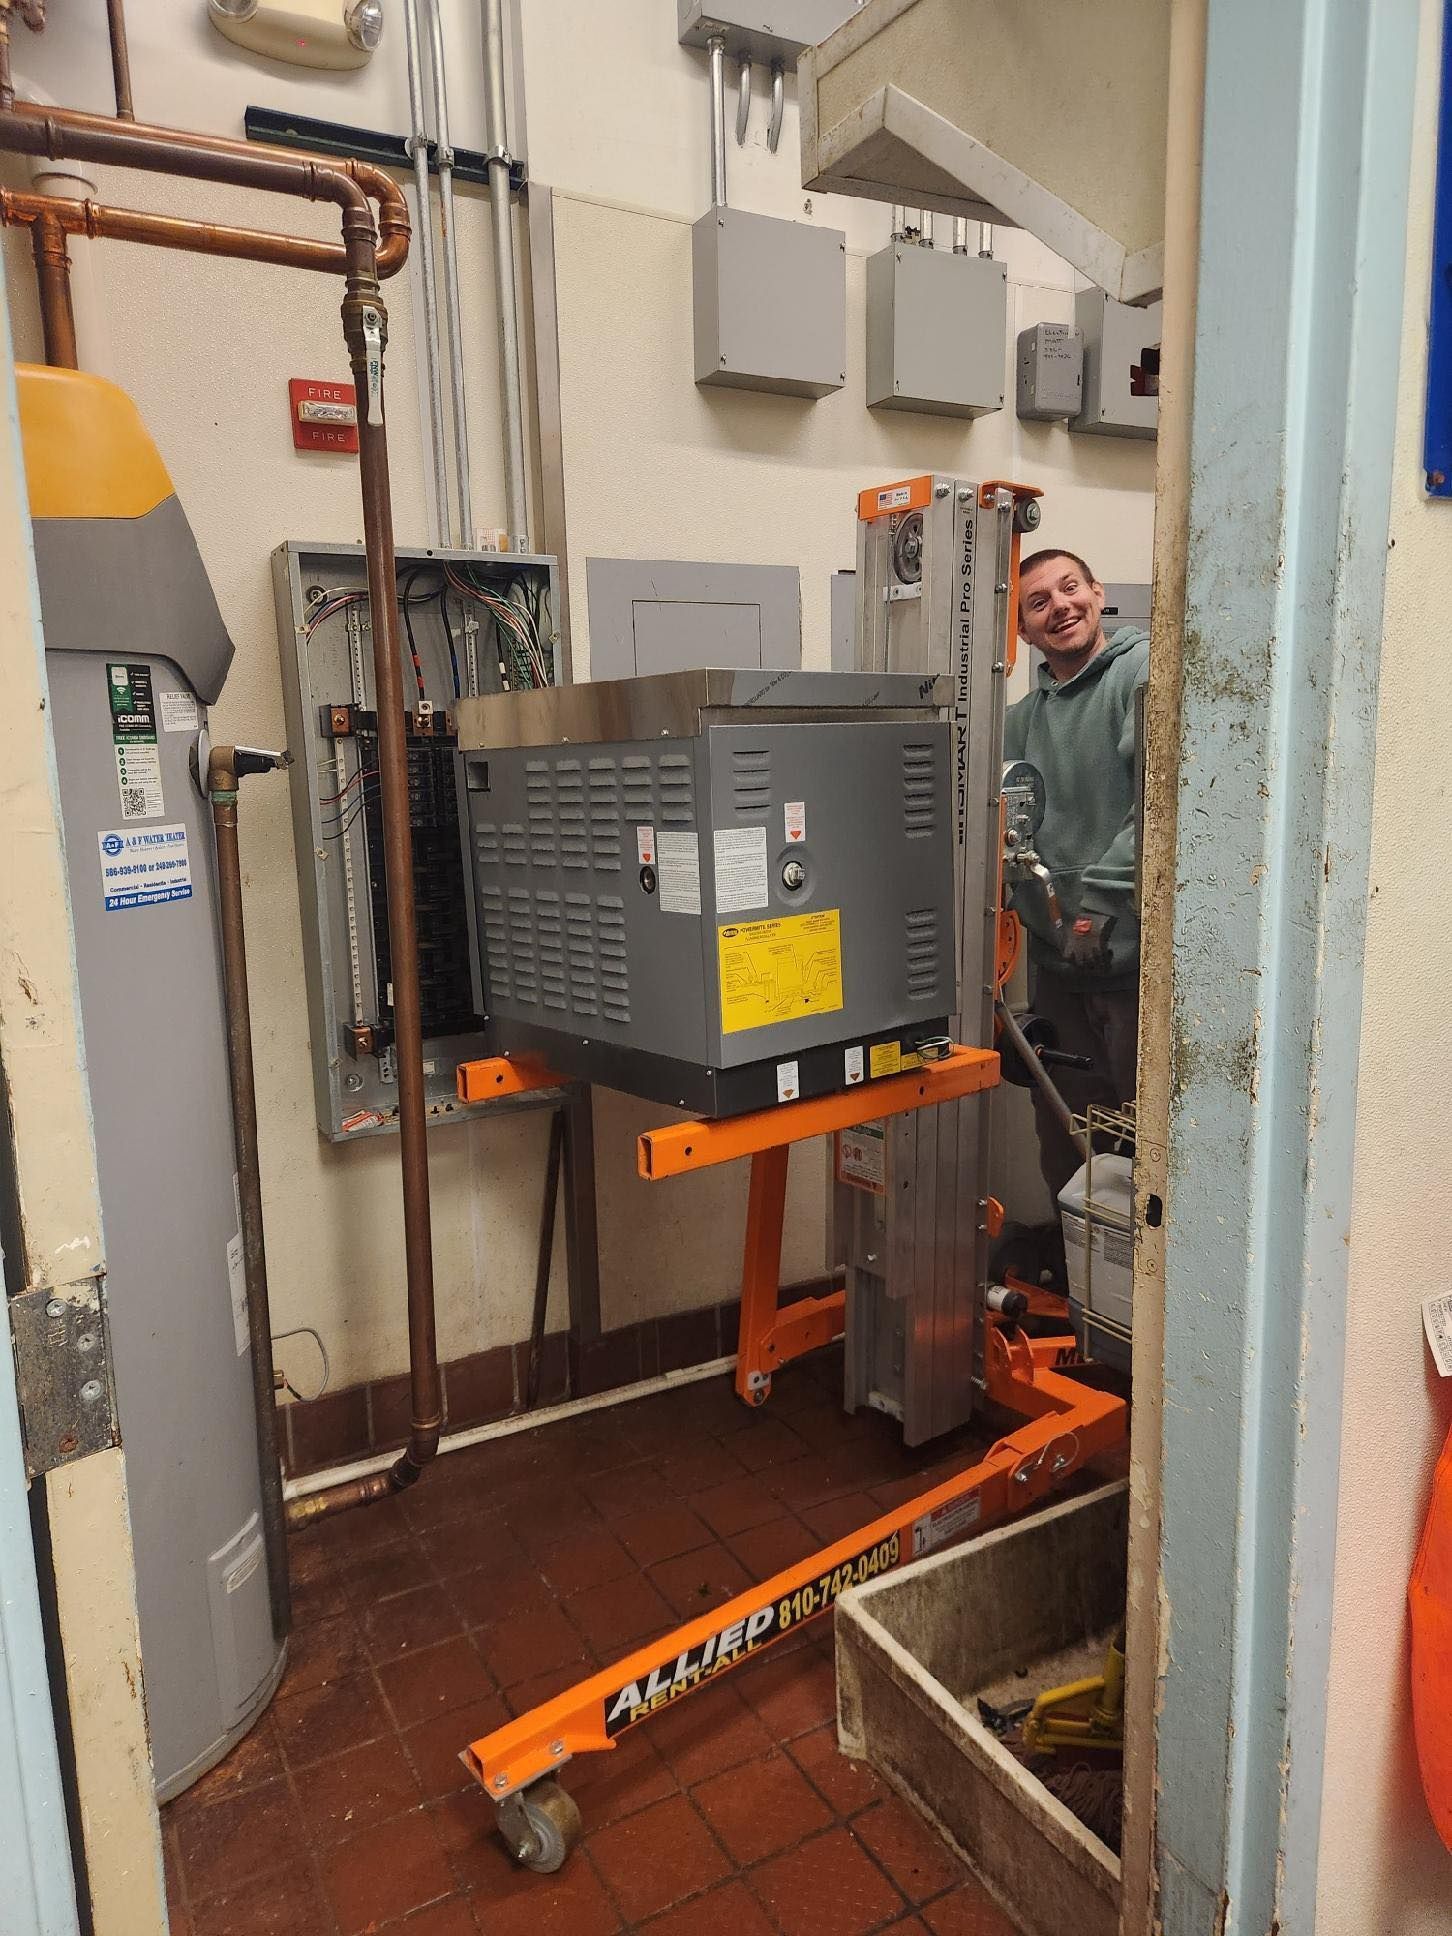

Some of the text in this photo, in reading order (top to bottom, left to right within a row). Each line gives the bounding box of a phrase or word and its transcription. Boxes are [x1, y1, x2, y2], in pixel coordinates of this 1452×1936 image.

[308, 387, 342, 400] FIRE
[312, 431, 345, 442] FIRE
[961, 519, 974, 576] Series
[960, 582, 972, 613] Pro
[957, 619, 971, 702] Industrial
[126, 837, 131, 847] A
[143, 834, 165, 844] WATER
[109, 887, 190, 908] 24 Hour Emergency Service
[606, 1534, 900, 1723] ALLIED 810-742-0409
[629, 1638, 763, 1723] RENT-ALL
